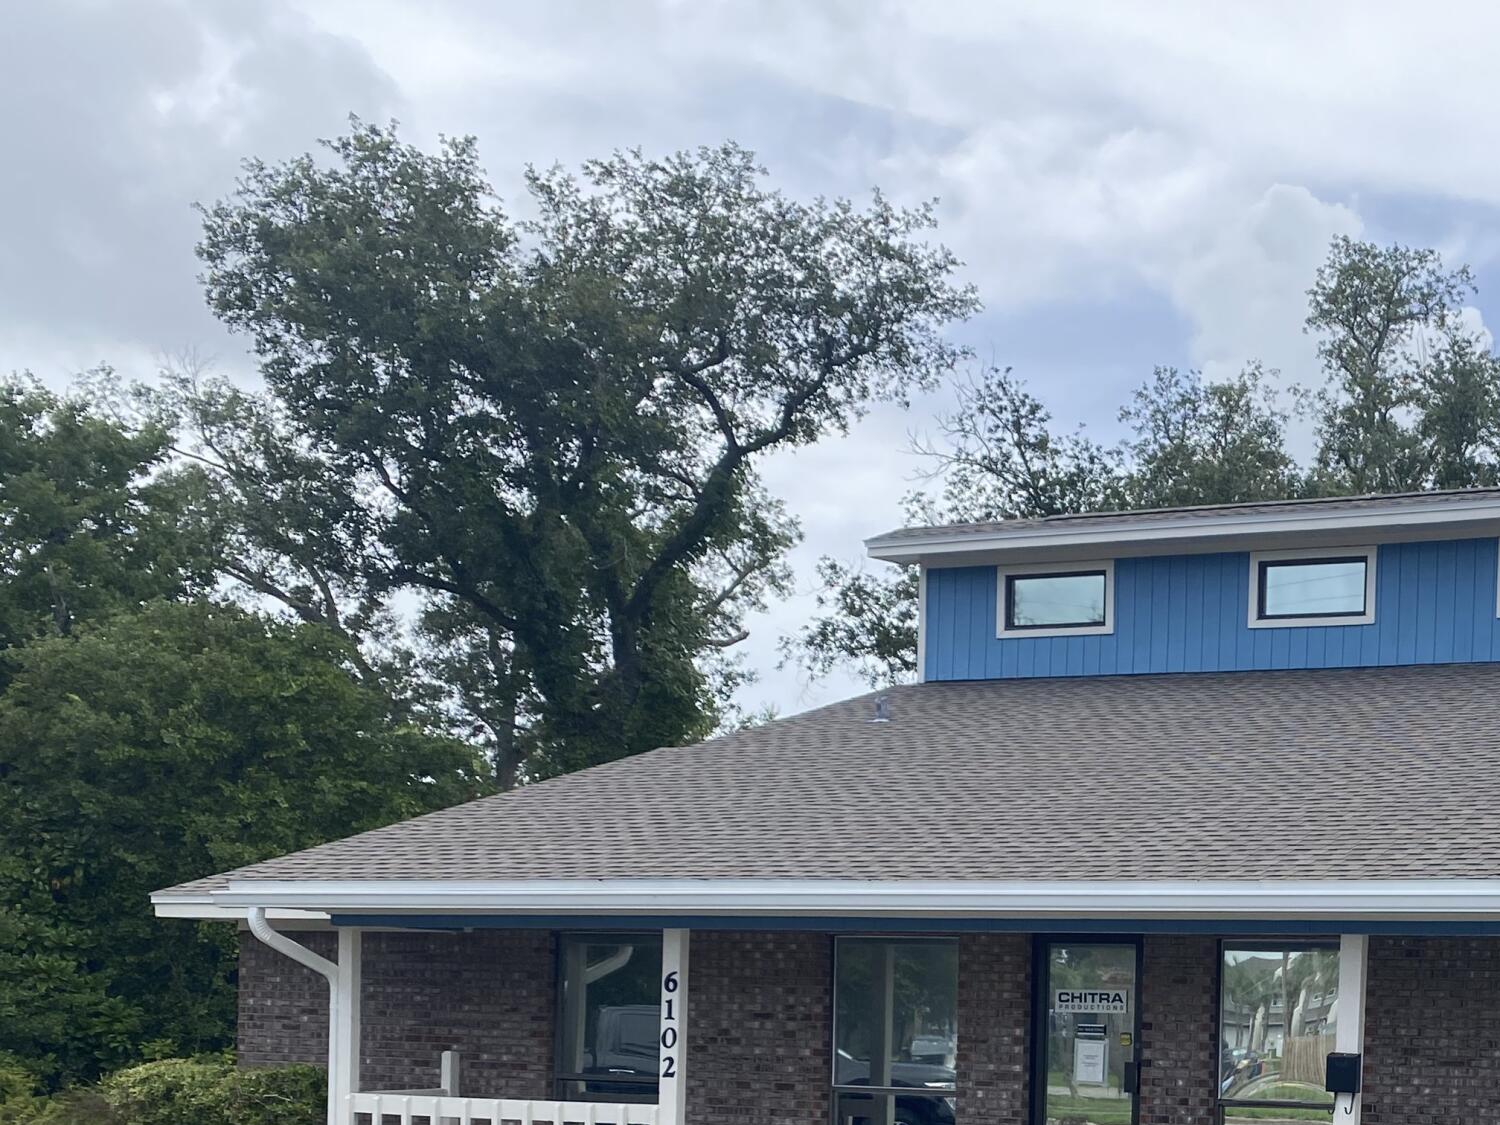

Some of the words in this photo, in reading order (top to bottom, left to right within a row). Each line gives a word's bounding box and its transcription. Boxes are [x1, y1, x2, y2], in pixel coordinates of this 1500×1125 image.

[1058, 991, 1124, 1004] CHITRA
[1058, 1003, 1124, 1011] PRODUCTIONS
[661, 971, 678, 1078] 6102
